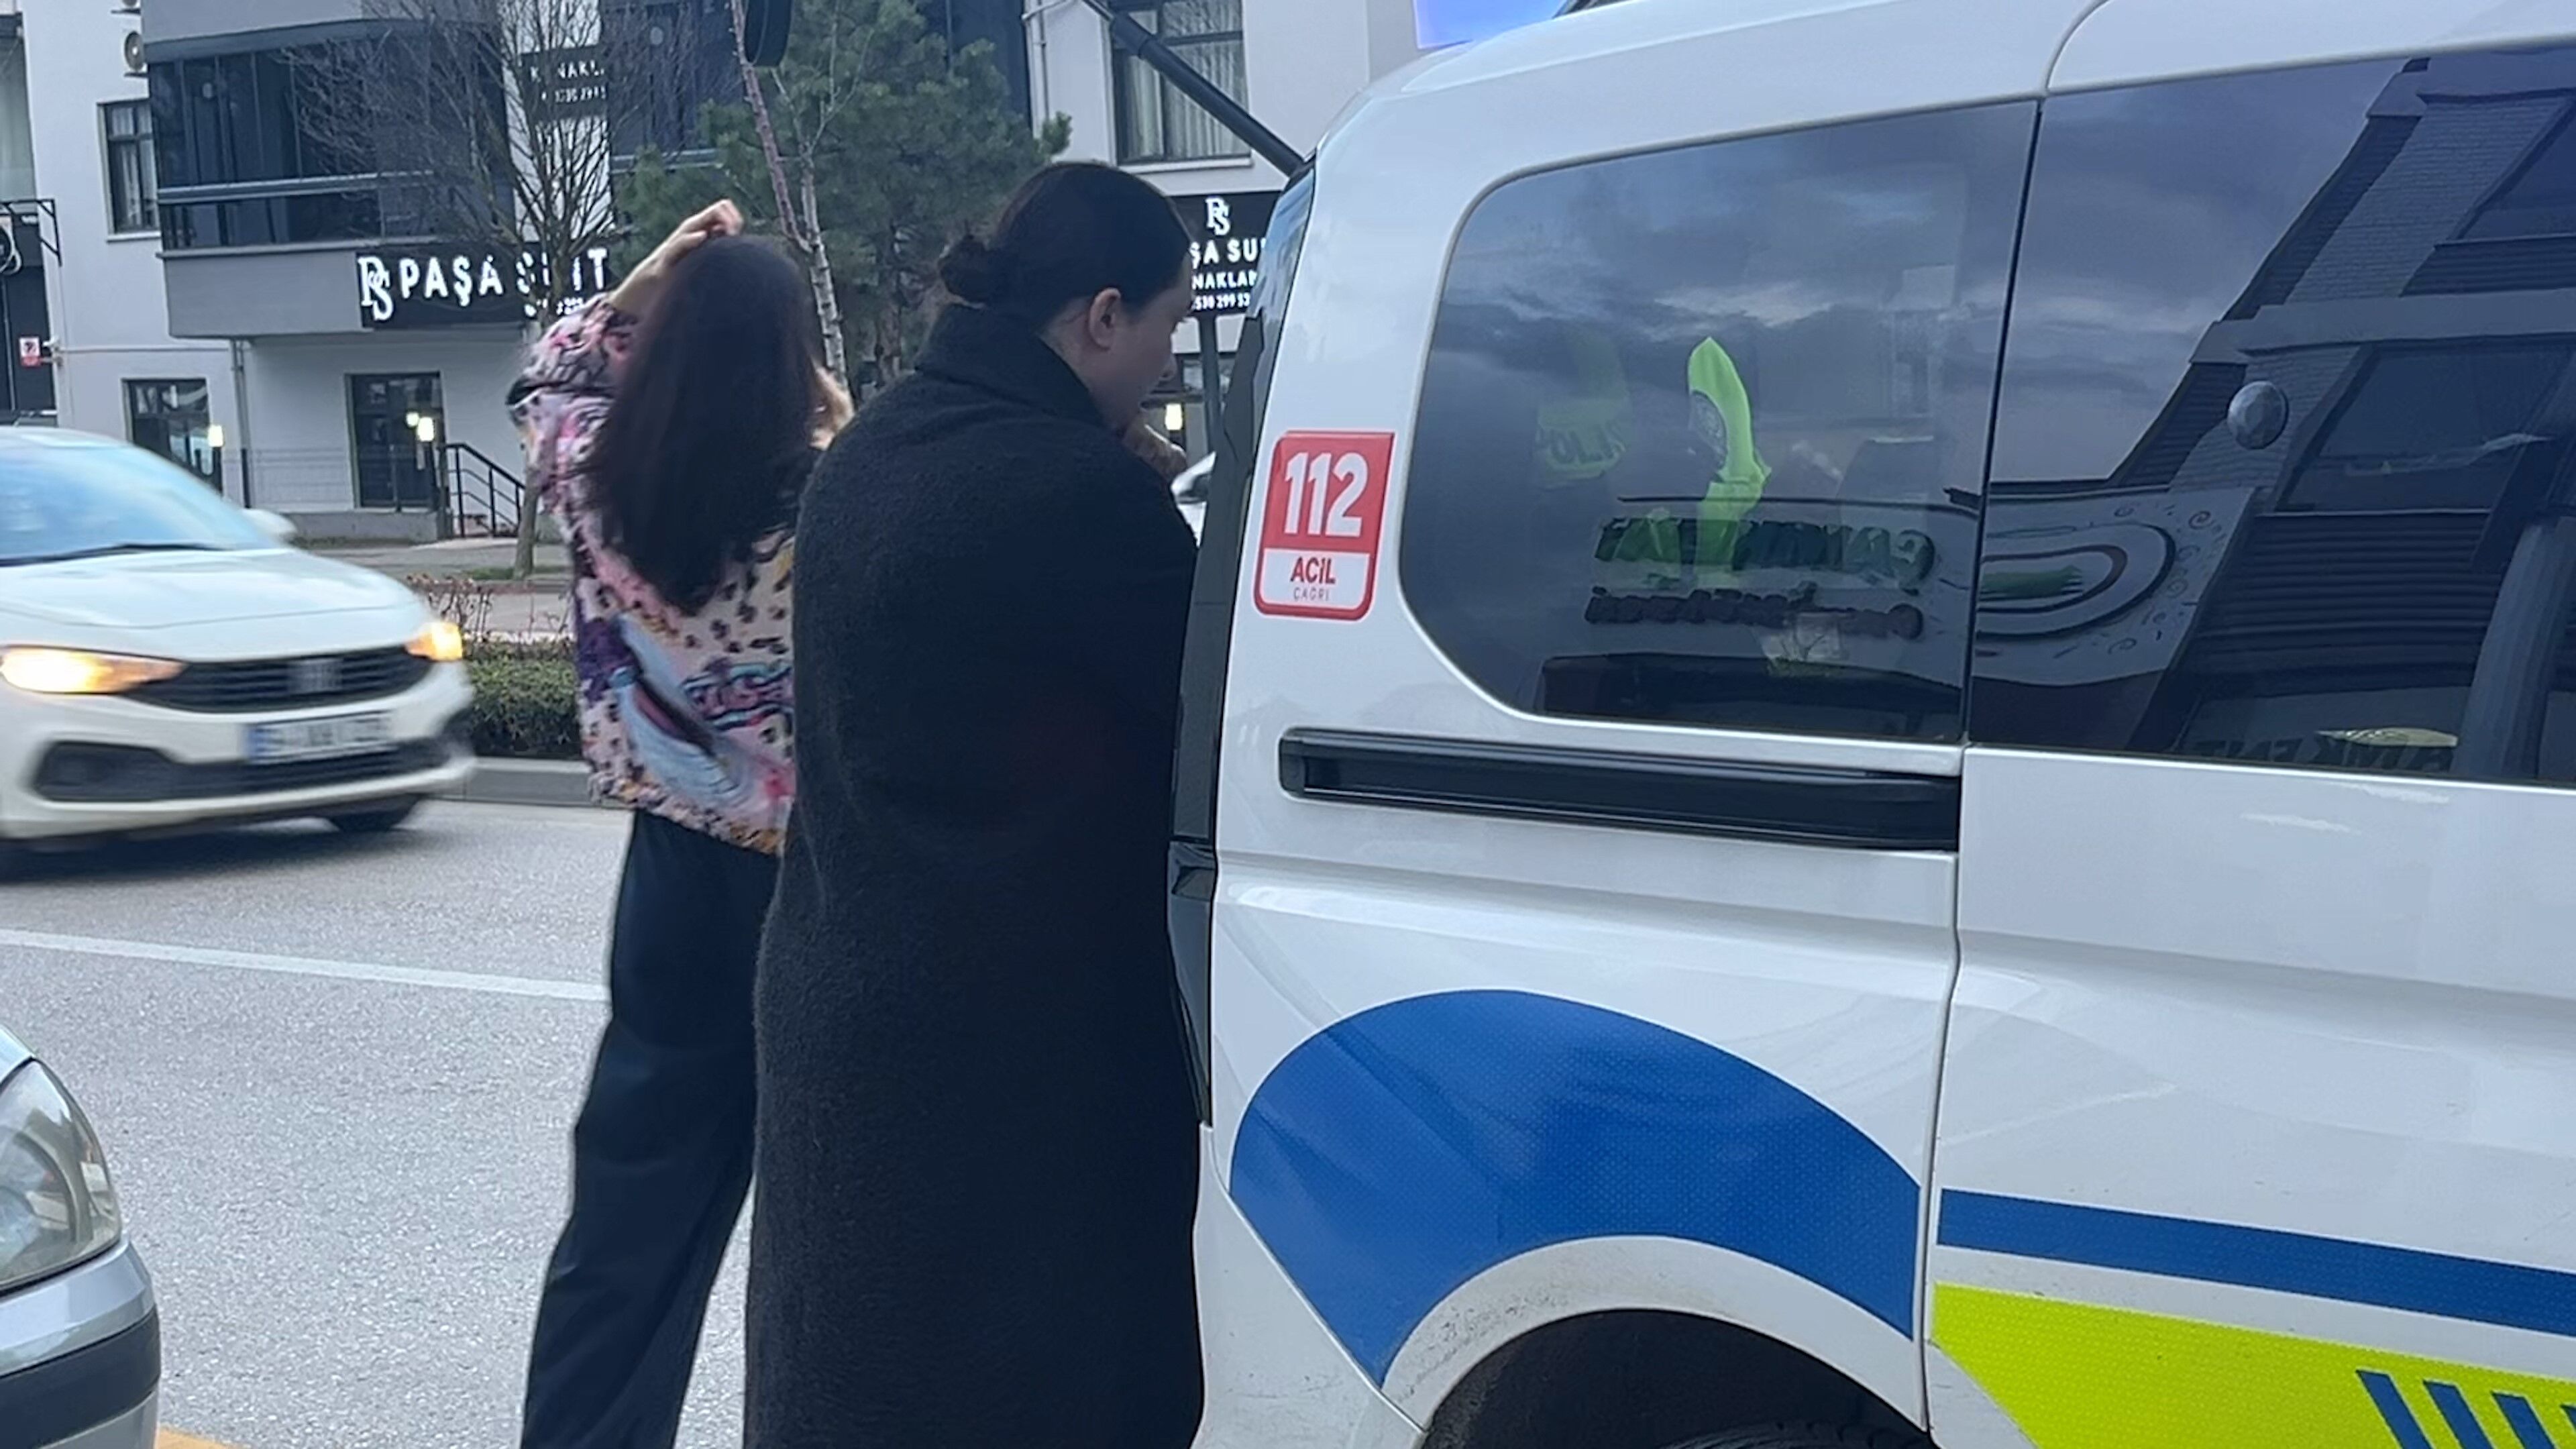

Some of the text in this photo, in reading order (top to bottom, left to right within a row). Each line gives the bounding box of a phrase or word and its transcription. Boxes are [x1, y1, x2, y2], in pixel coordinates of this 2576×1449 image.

[1226, 237, 1267, 263] SU
[398, 254, 504, 307] PAŞA
[1284, 451, 1369, 537] 112
